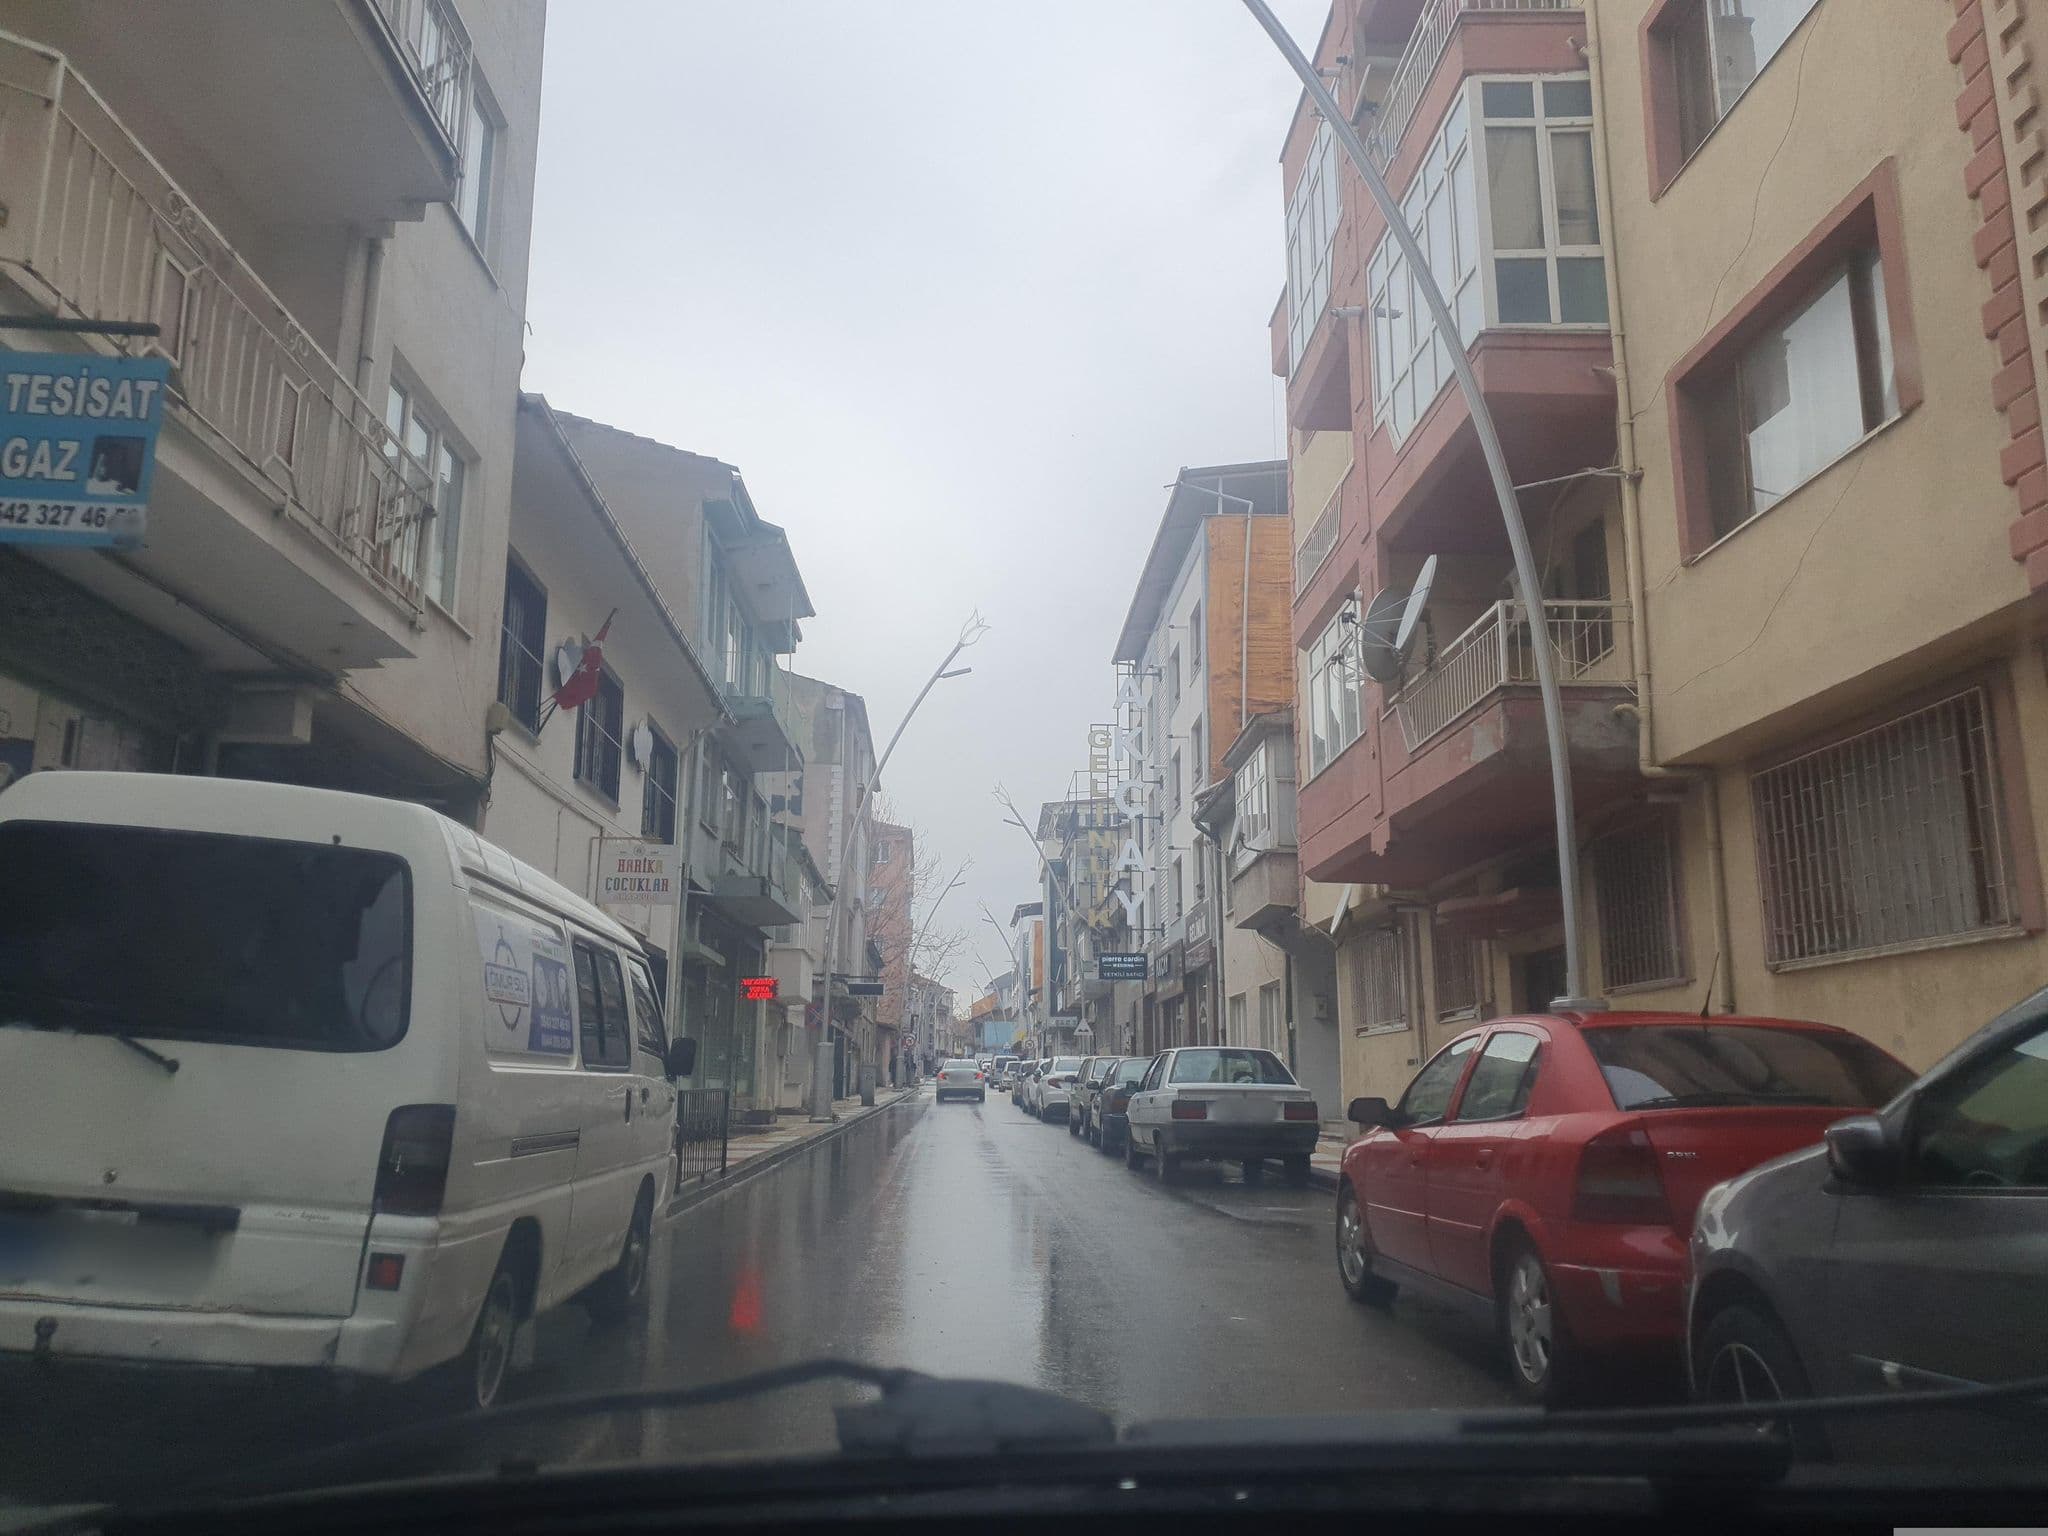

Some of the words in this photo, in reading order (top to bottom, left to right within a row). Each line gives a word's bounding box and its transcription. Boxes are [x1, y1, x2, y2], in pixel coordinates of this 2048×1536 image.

[7, 367, 159, 420] TESİSAT
[1, 437, 80, 481] GAZ
[35, 504, 75, 527] 327
[81, 506, 107, 528] 46
[1113, 676, 1148, 927] AKÇAY
[617, 857, 663, 874] HARİKA
[1101, 955, 1122, 963] pierre
[1123, 955, 1145, 963] cardin
